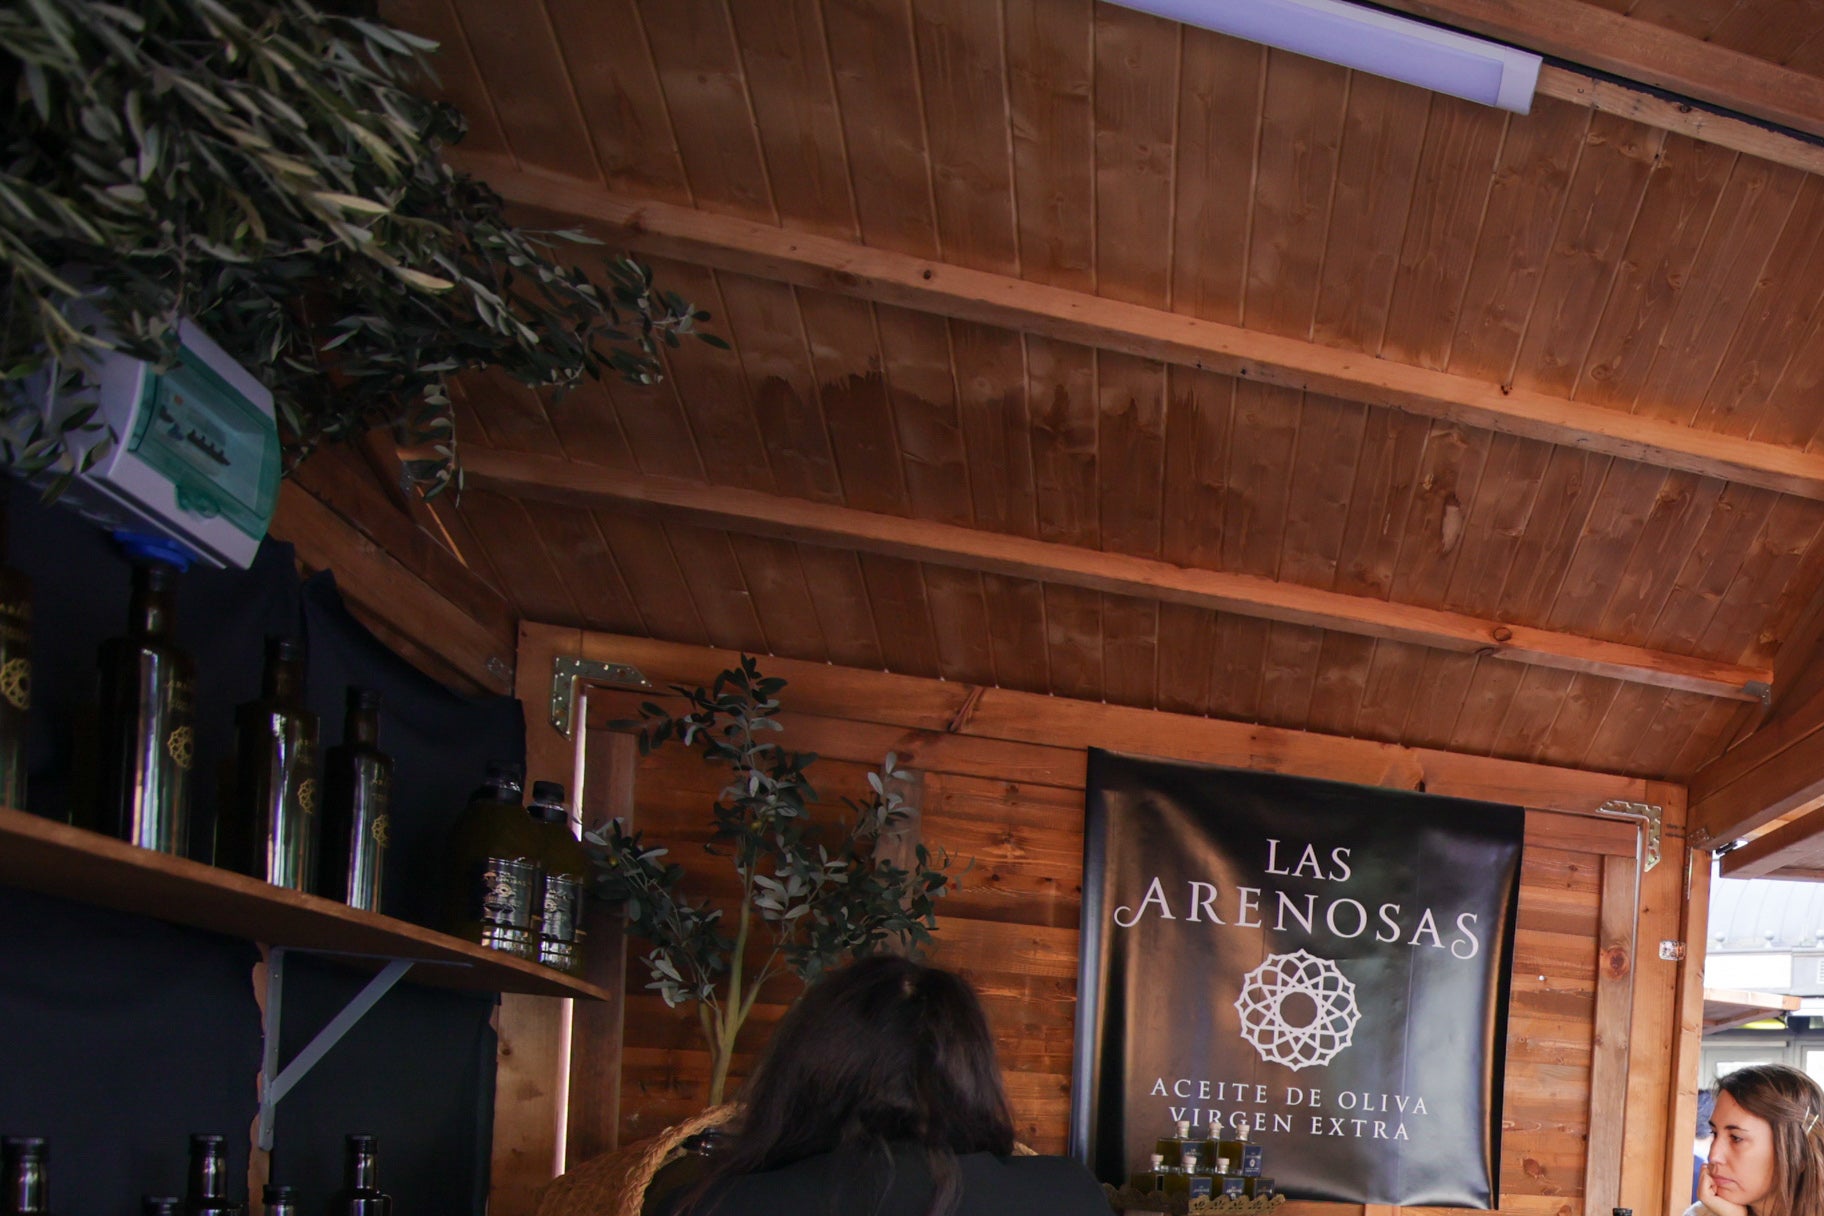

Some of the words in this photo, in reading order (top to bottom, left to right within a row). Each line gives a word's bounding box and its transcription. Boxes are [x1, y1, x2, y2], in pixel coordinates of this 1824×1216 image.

[1265, 838, 1352, 883] LAS
[1113, 876, 1480, 960] ARENOSAS
[1150, 1078, 1268, 1104] ACEITE
[1286, 1086, 1323, 1108] DE
[1337, 1090, 1428, 1116] OLIVA
[1168, 1106, 1293, 1134] VIRGEN
[1311, 1116, 1410, 1141] EXTRA
